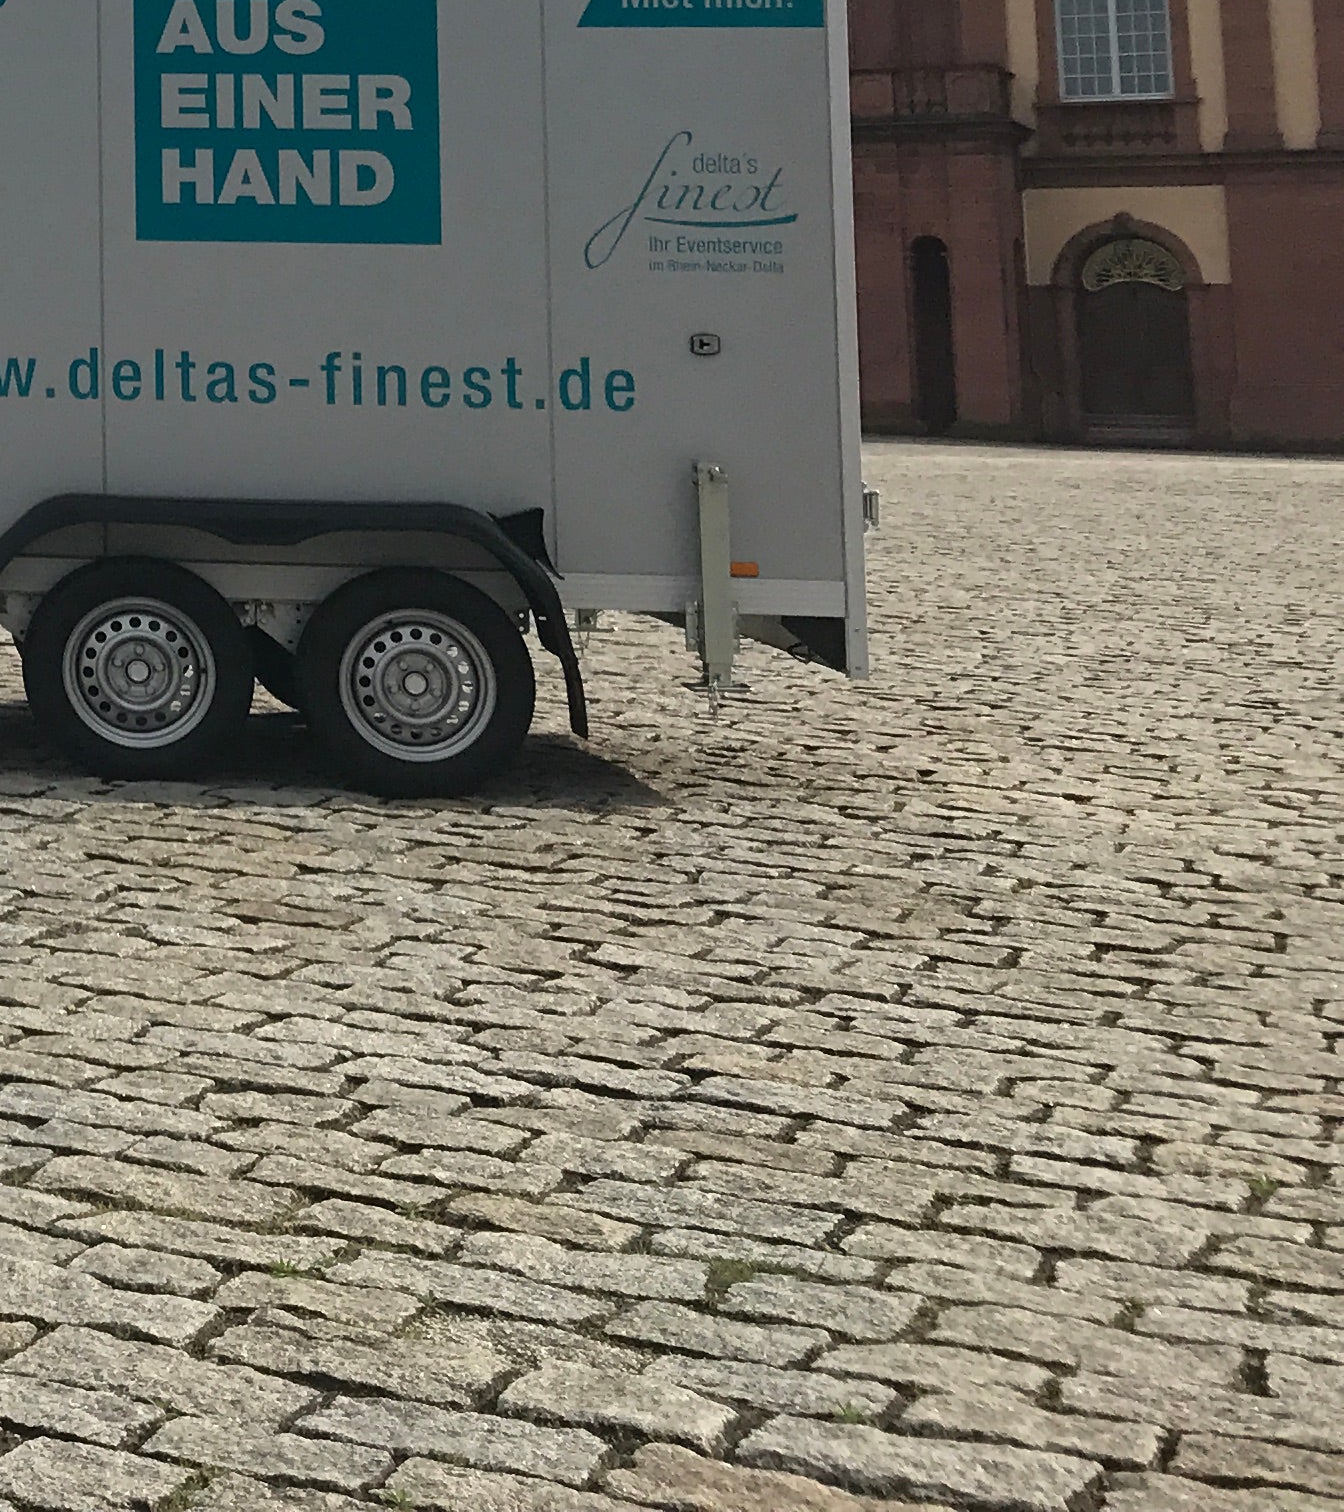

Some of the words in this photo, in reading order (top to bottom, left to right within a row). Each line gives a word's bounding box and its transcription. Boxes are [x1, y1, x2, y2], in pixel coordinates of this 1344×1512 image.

[160, 73, 413, 130] EINER
[161, 148, 394, 206] HAND
[584, 130, 786, 270] finest
[648, 237, 671, 253] Ihr
[677, 236, 783, 254] Eventservice
